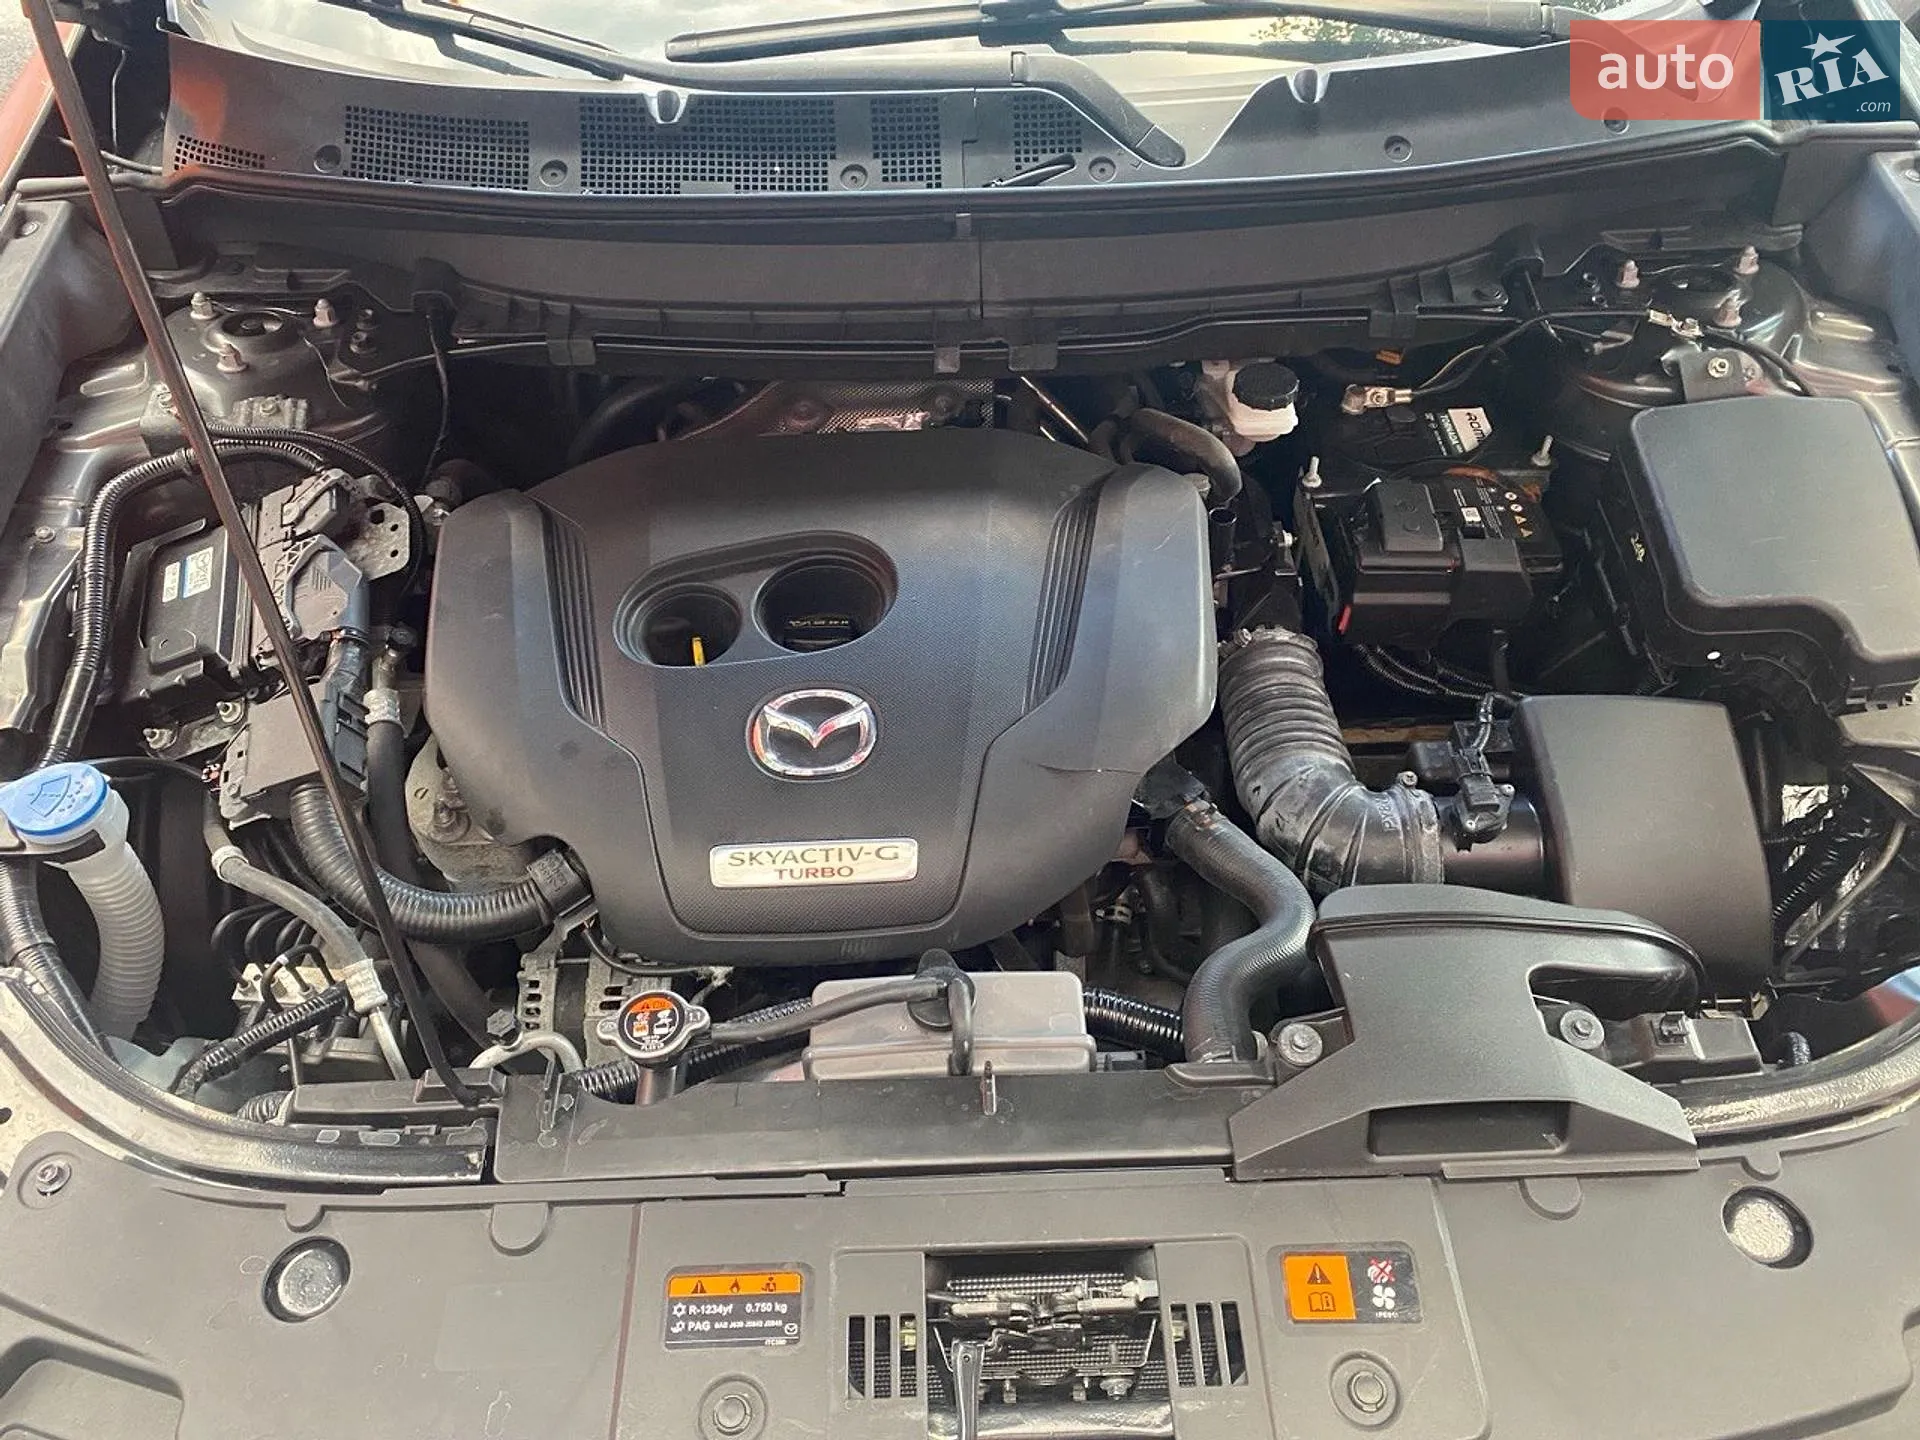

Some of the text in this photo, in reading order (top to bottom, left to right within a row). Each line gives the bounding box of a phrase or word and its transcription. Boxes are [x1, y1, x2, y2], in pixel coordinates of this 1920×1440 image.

[728, 845, 900, 867] SKYACTIV-G
[773, 865, 855, 880] TURBO
[688, 1302, 788, 1316] R-1234yf 0.750 kg
[687, 1321, 711, 1331] PAG
